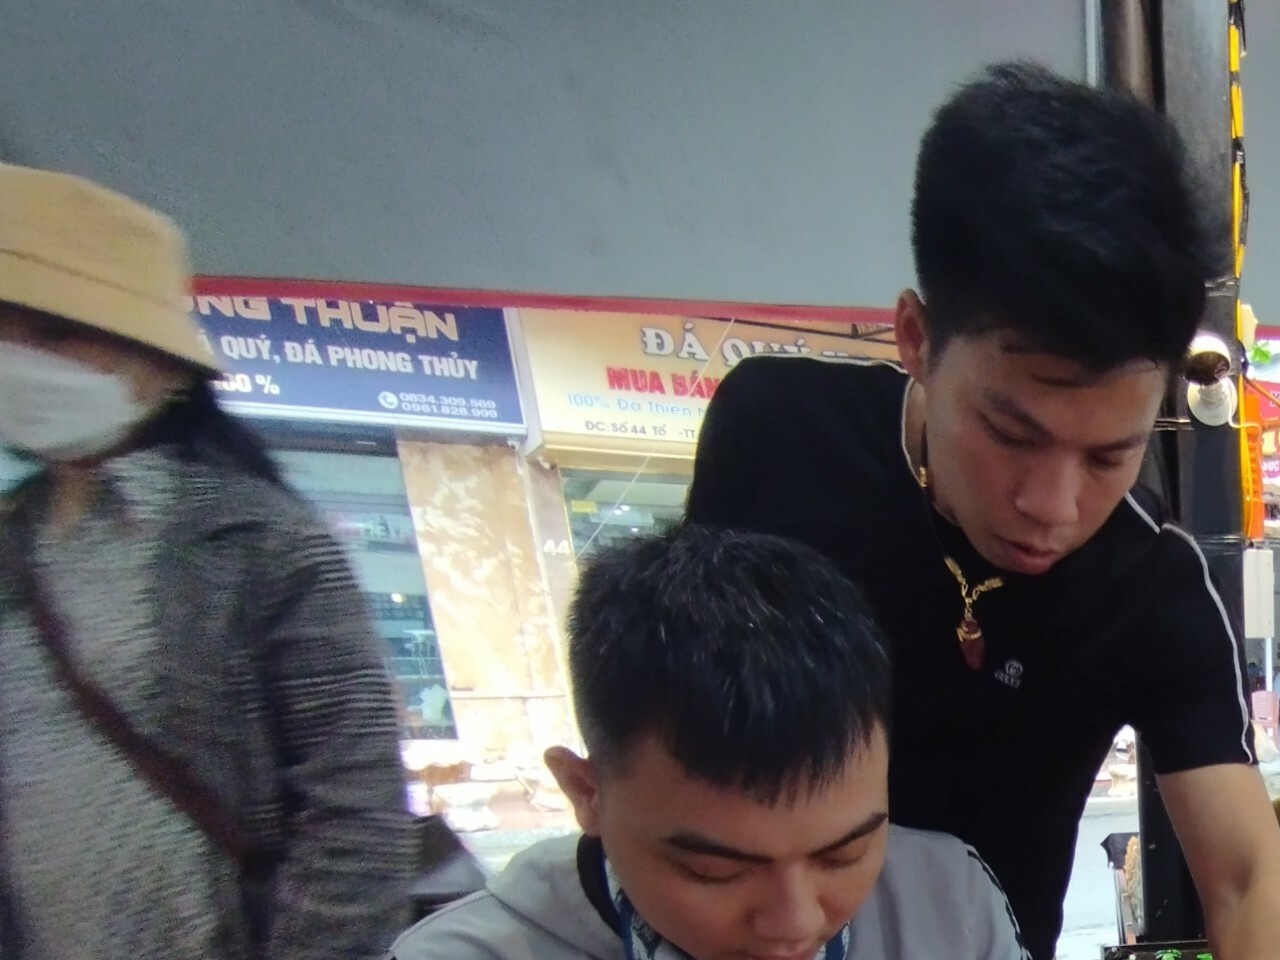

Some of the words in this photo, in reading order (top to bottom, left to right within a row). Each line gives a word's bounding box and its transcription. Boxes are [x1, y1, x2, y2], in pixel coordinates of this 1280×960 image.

[278, 298, 459, 344] THUẬN
[284, 338, 324, 366] ĐÁ
[327, 345, 414, 374] PHONG
[417, 351, 479, 381] THỦY
[641, 322, 709, 362] ĐÁ
[606, 366, 666, 395] MUA
[401, 402, 498, 419] 0961.828.999
